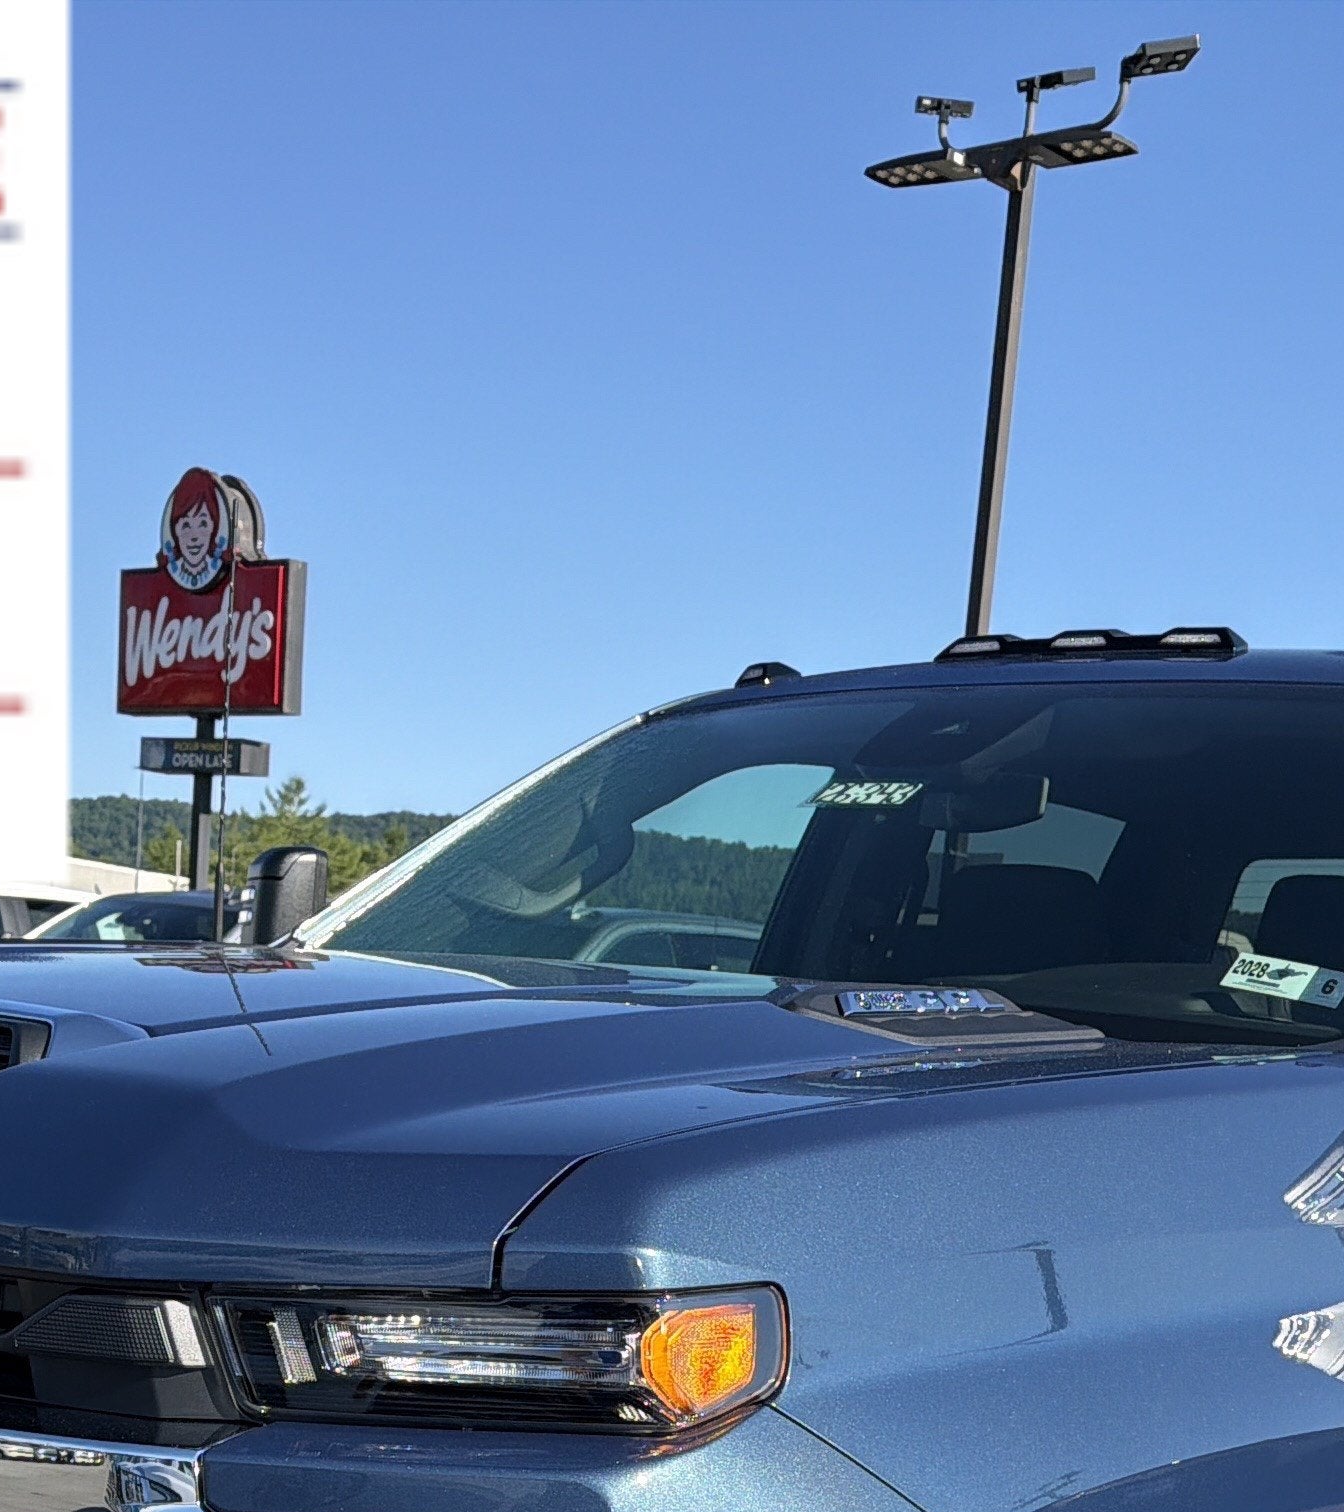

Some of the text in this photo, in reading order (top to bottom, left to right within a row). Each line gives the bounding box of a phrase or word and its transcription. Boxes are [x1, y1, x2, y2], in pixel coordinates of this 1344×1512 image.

[124, 587, 274, 687] Wendy's
[1232, 958, 1271, 979] 2028
[1320, 978, 1339, 995] 6
